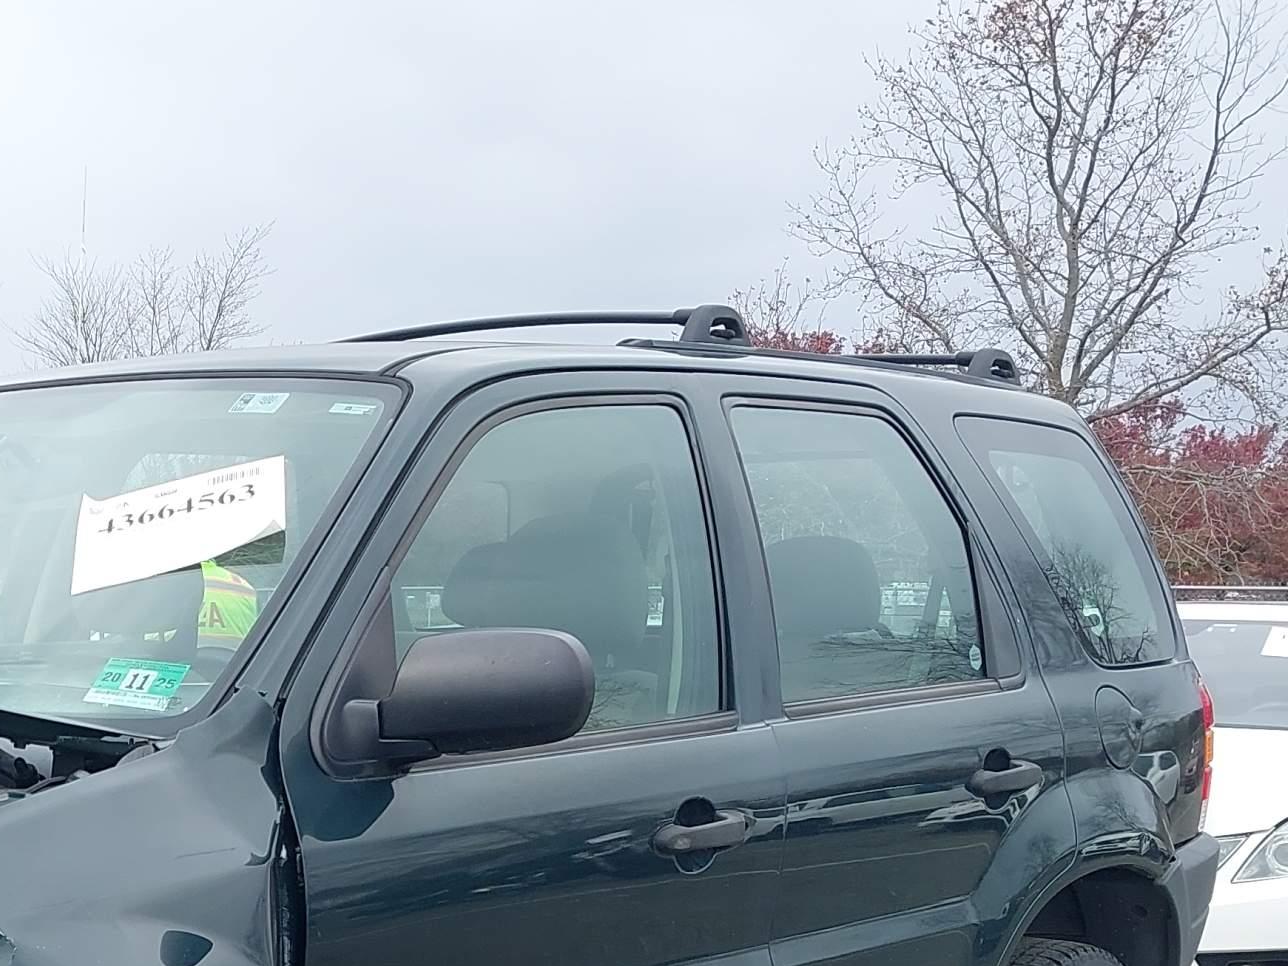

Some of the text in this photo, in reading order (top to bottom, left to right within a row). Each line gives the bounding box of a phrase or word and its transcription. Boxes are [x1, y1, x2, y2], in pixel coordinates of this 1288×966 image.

[97, 483, 257, 535] 43664563
[101, 671, 177, 691] 20 11 25
